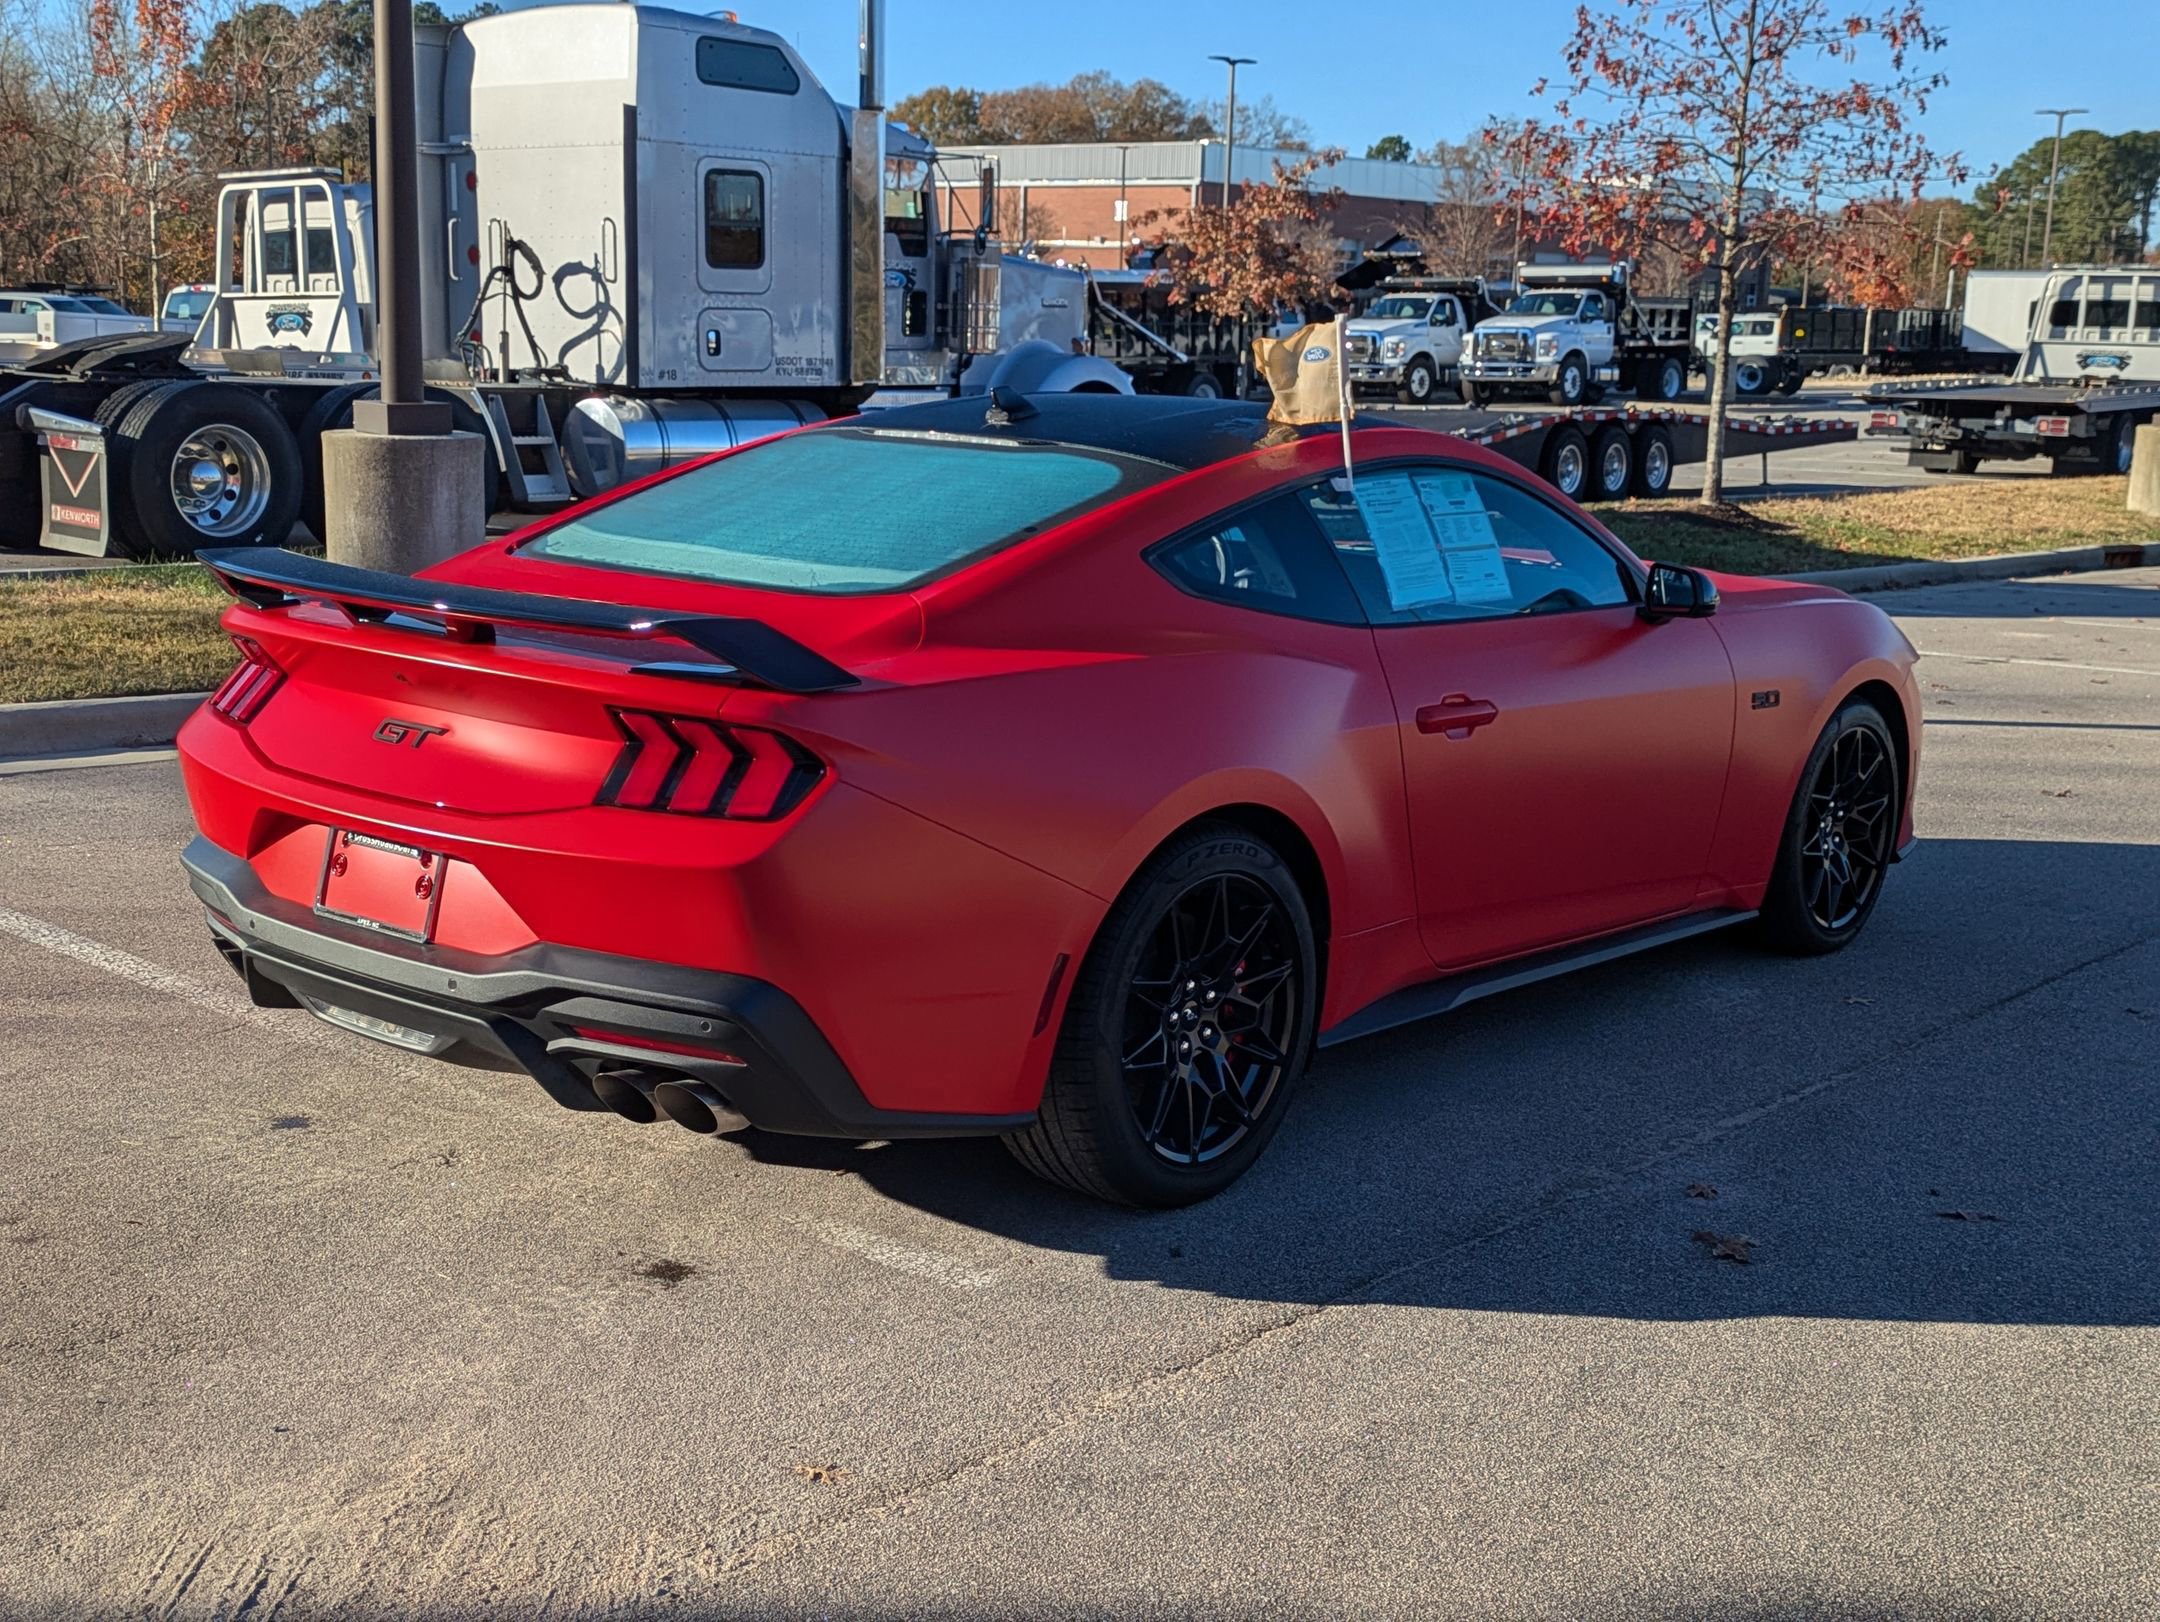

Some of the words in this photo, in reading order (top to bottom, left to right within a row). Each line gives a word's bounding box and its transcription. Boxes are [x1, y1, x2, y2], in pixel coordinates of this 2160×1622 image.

[775, 356, 803, 366] USDOT
[658, 369, 677, 380] #18
[61, 510, 100, 525] KENWORTH
[373, 717, 450, 748] GT
[1187, 851, 1200, 869] P
[1205, 842, 1259, 859] ZERO
